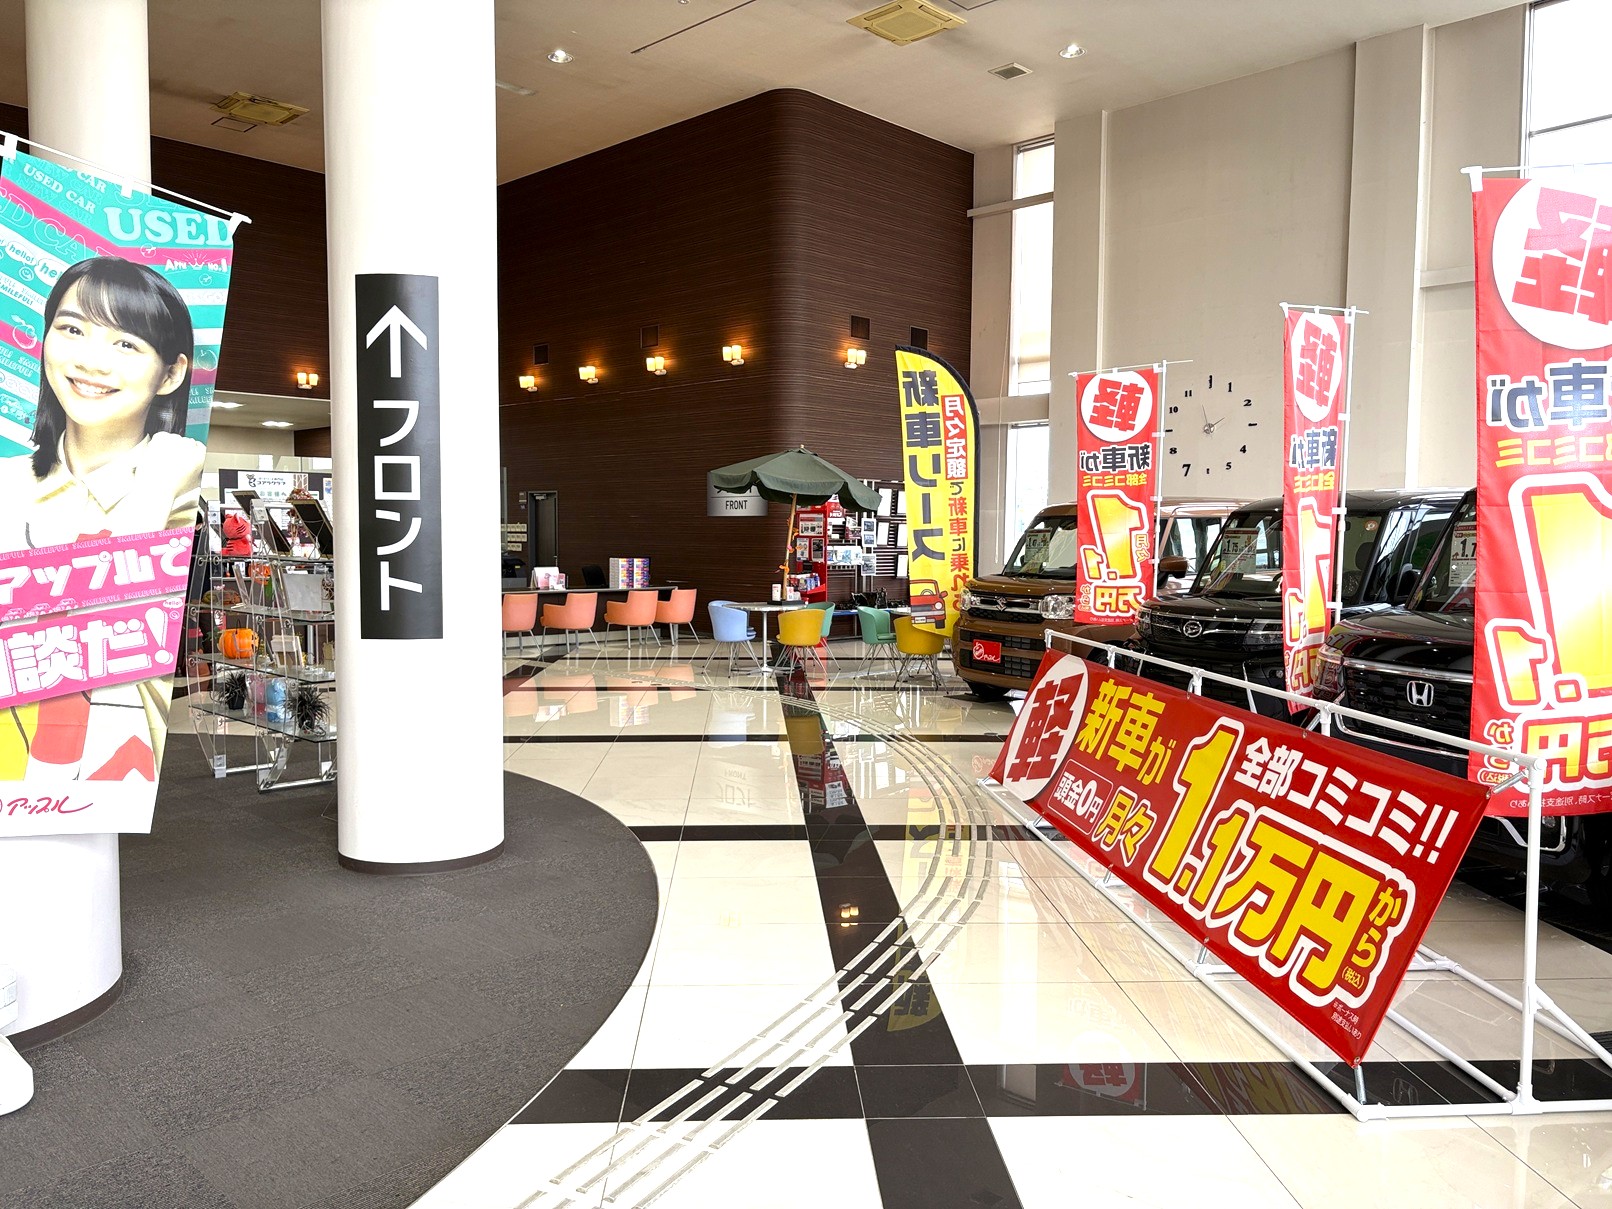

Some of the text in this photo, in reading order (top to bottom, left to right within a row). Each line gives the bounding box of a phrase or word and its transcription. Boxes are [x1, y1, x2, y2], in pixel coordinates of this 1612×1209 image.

[23, 163, 96, 214] USED CAR
[103, 207, 233, 246] USED
[1168, 406, 1179, 414] 10
[1243, 399, 1252, 407] 2
[1169, 447, 1178, 455] 8
[1182, 463, 1192, 477] 7
[1225, 461, 1232, 471] 5
[1239, 444, 1247, 454] 4
[373, 400, 423, 611] フロント
[725, 500, 748, 510] FRONT
[0, 536, 192, 605] アップルで
[1006, 673, 1085, 783] 軽
[1075, 678, 1176, 785] 新車が
[1054, 771, 1105, 824] 頭金0円
[1233, 737, 1460, 864] 全部コミコミ!!
[1097, 792, 1153, 860] 月々
[1350, 885, 1402, 968] から
[1341, 965, 1365, 990] (税込)
